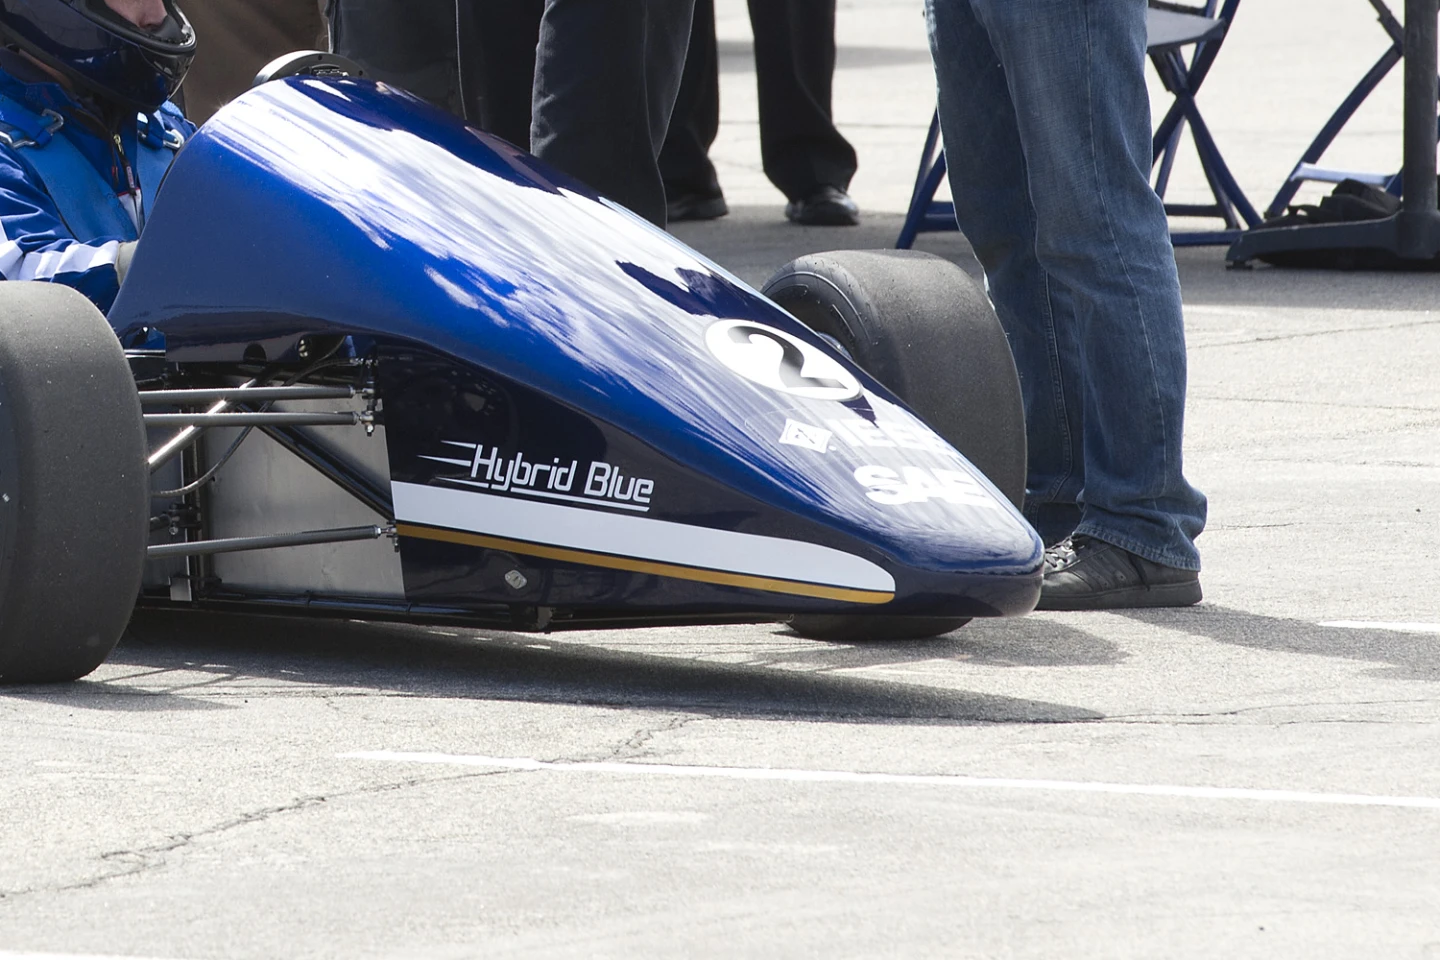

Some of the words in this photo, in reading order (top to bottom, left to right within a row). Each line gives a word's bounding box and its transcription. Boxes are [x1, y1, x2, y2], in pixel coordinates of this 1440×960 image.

[727, 325, 849, 390] 2
[470, 444, 578, 492] Hybrid
[583, 460, 655, 504] Blue
[853, 464, 998, 509] SAE
